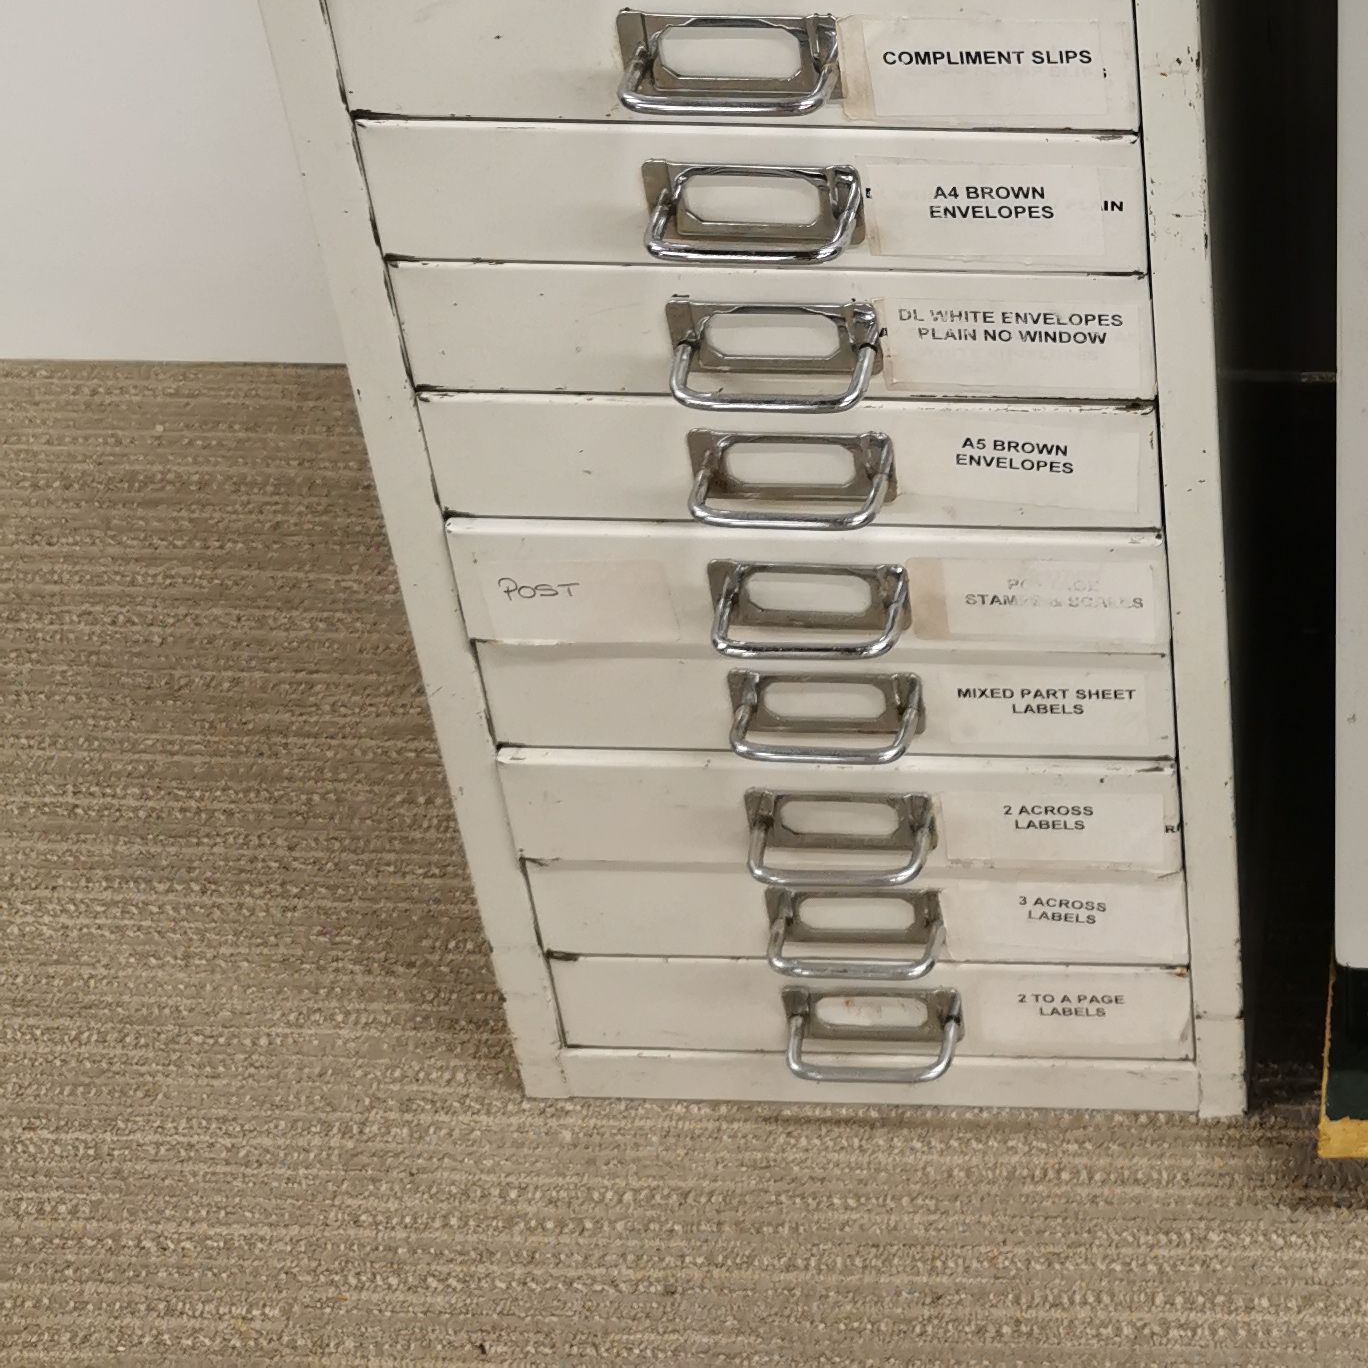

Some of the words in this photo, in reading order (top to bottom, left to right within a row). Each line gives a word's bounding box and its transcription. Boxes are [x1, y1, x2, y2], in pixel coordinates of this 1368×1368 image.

[882, 50, 1025, 65] COMPLIMENT
[1031, 49, 1093, 65] SLIPS
[933, 186, 959, 200] A4
[965, 186, 1046, 200] BROWN
[929, 205, 1055, 220] ENVELOPES
[898, 308, 925, 323] DL
[930, 309, 996, 324] WHITE
[1001, 311, 1124, 327] ENVELOPES
[917, 327, 977, 341] PLAIN
[983, 328, 1013, 343] NO
[1018, 330, 1108, 345] WINDOW
[961, 437, 987, 450] A5
[993, 439, 1069, 457] BROWN
[955, 453, 1075, 474] ENVELOPES
[498, 577, 580, 601] POST
[957, 687, 1015, 700] MIXED
[1020, 688, 1070, 700] PART
[1075, 689, 1137, 701] SHEET
[1012, 703, 1085, 715] LABELS
[1003, 805, 1012, 816] 2
[1018, 805, 1094, 817] ACROSS
[1014, 819, 1086, 831] LABELS
[1018, 896, 1028, 906] 3
[1033, 897, 1108, 913] ACROSS
[1027, 910, 1097, 925] LABELS
[1018, 993, 1027, 1004] 2
[1031, 994, 1056, 1004] TO
[1060, 994, 1073, 1005] A
[1077, 994, 1126, 1005] PAGE
[1039, 1006, 1107, 1018] LABELS
